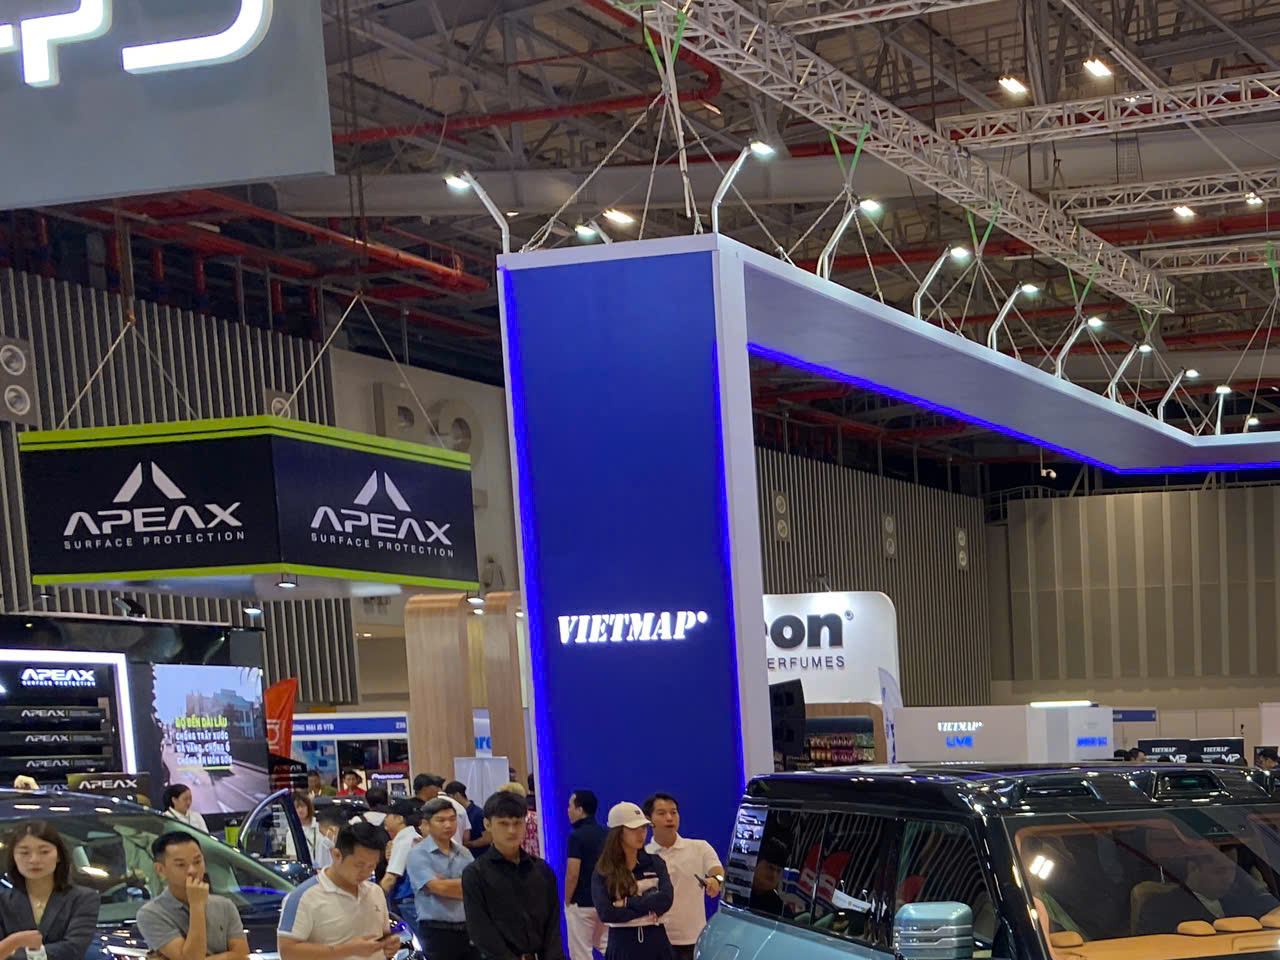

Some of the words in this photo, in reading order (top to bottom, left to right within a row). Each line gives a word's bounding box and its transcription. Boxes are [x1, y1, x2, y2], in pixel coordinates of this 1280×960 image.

[63, 502, 243, 536] APEAX
[310, 505, 453, 545] APEAX
[64, 537, 133, 550] SURFACE
[143, 531, 245, 545] PROTECTION
[311, 533, 371, 548] SURFACE
[378, 541, 454, 558] PROTECTION
[765, 612, 843, 649] on
[21, 668, 95, 681] APEAX
[946, 736, 974, 747] LIVE
[79, 779, 138, 790] APEAX
